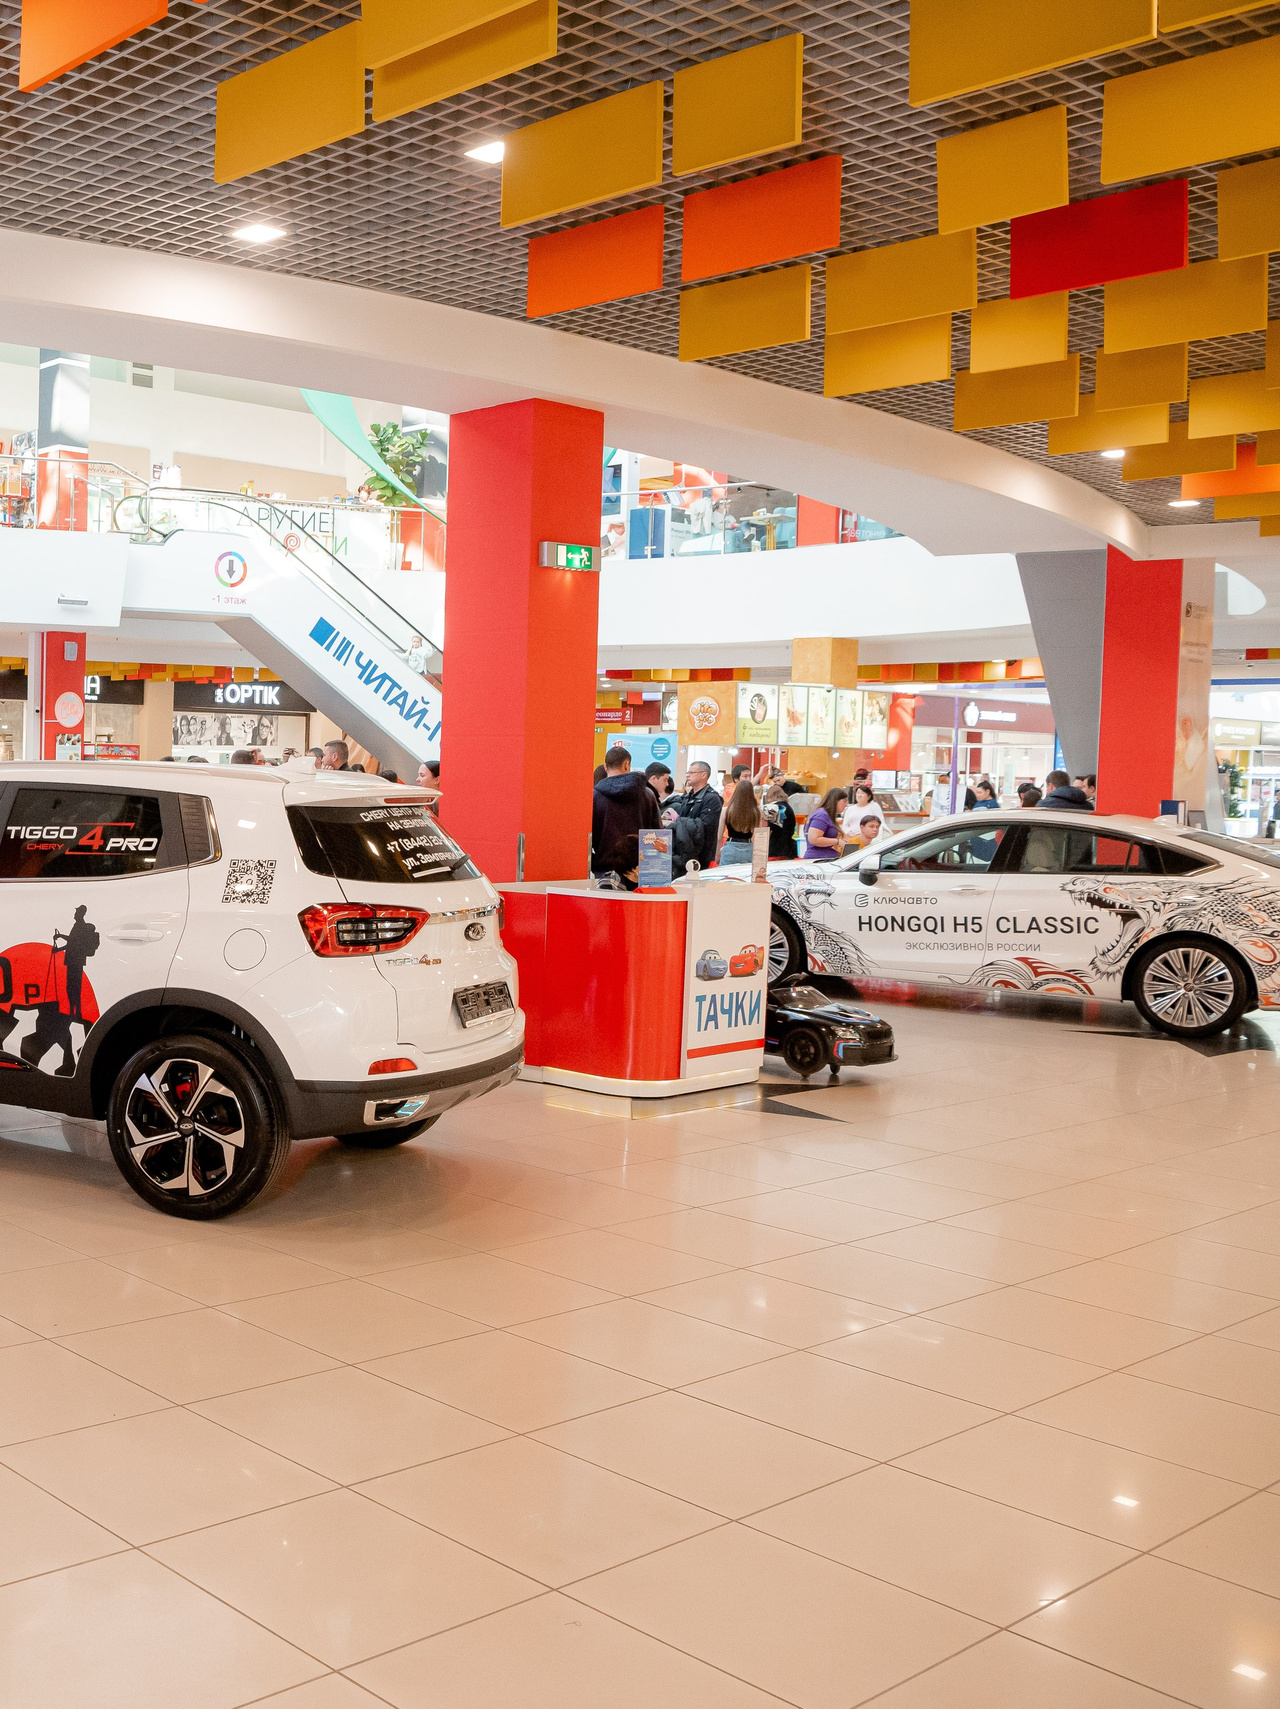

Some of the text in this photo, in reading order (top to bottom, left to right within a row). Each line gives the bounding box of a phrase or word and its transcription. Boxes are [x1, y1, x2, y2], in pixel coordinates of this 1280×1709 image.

[236, 506, 330, 534] ДРУГИЕ
[224, 596, 247, 606] этаж
[224, 683, 280, 706] OPTIK
[359, 808, 390, 822] CHERY
[390, 806, 414, 818] ЦЕНТР
[386, 820, 403, 832] НА
[6, 825, 159, 852] TIGGO 4 PRO
[26, 843, 65, 851] CHERY
[386, 840, 402, 853] +7
[399, 835, 432, 851] (8442)
[402, 857, 420, 871] ул.
[858, 915, 1100, 935] HONGQI H5 CLASSIC
[905, 942, 1041, 952] ЭКСКЛЮЗИВНО В РОССИИ
[695, 989, 761, 1033] ТАЧКИ
